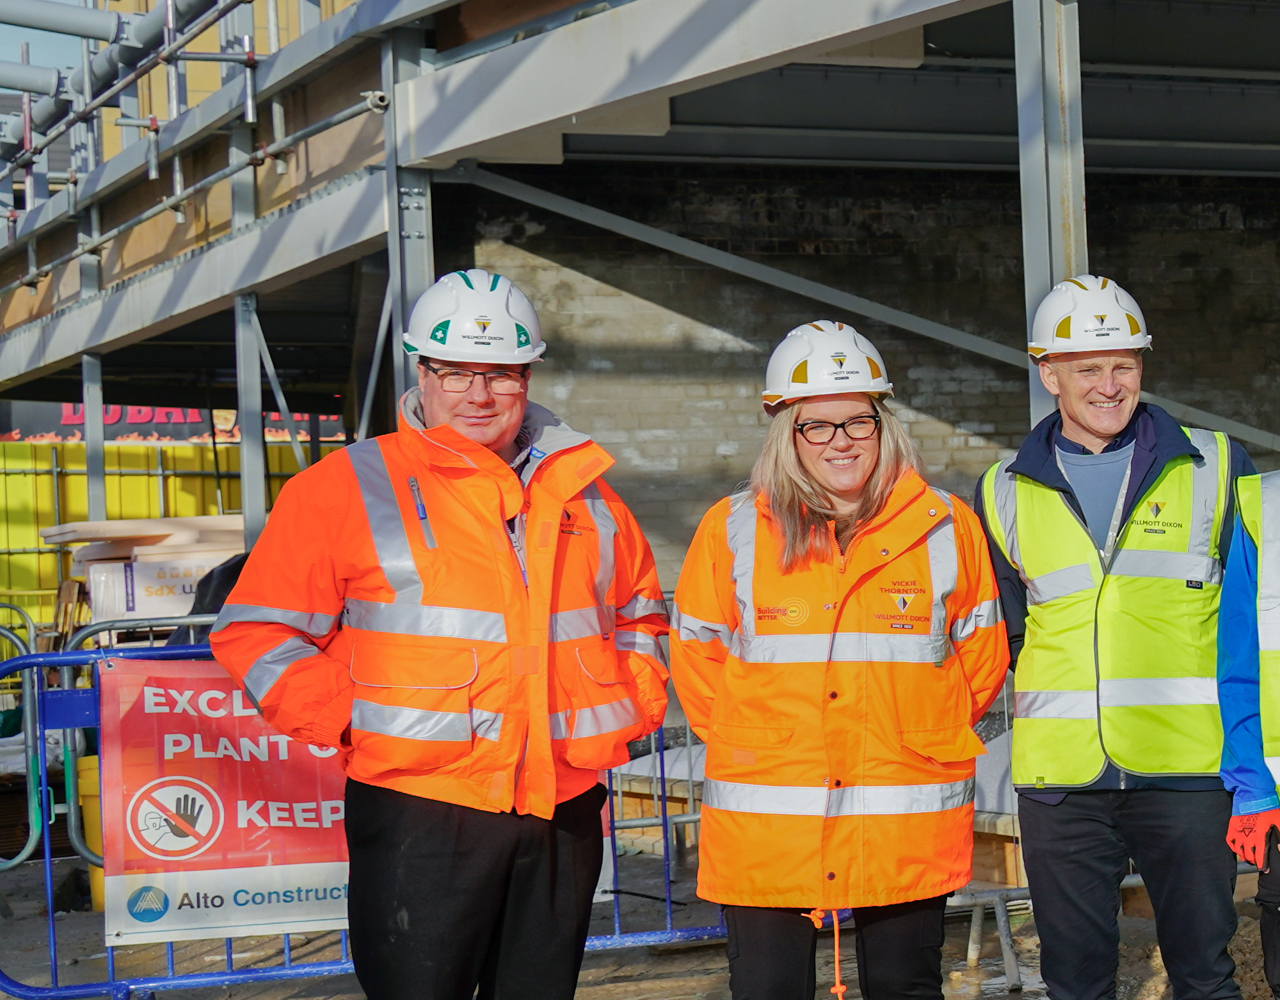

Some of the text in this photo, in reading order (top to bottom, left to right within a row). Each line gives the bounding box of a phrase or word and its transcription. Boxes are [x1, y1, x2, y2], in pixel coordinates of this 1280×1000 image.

[145, 585, 178, 597] XPS
[757, 606, 787, 616] Building
[144, 686, 257, 718] EXCL
[164, 733, 294, 761] PLANT
[237, 800, 345, 829] KEEP
[177, 883, 348, 910] Alto Construct
